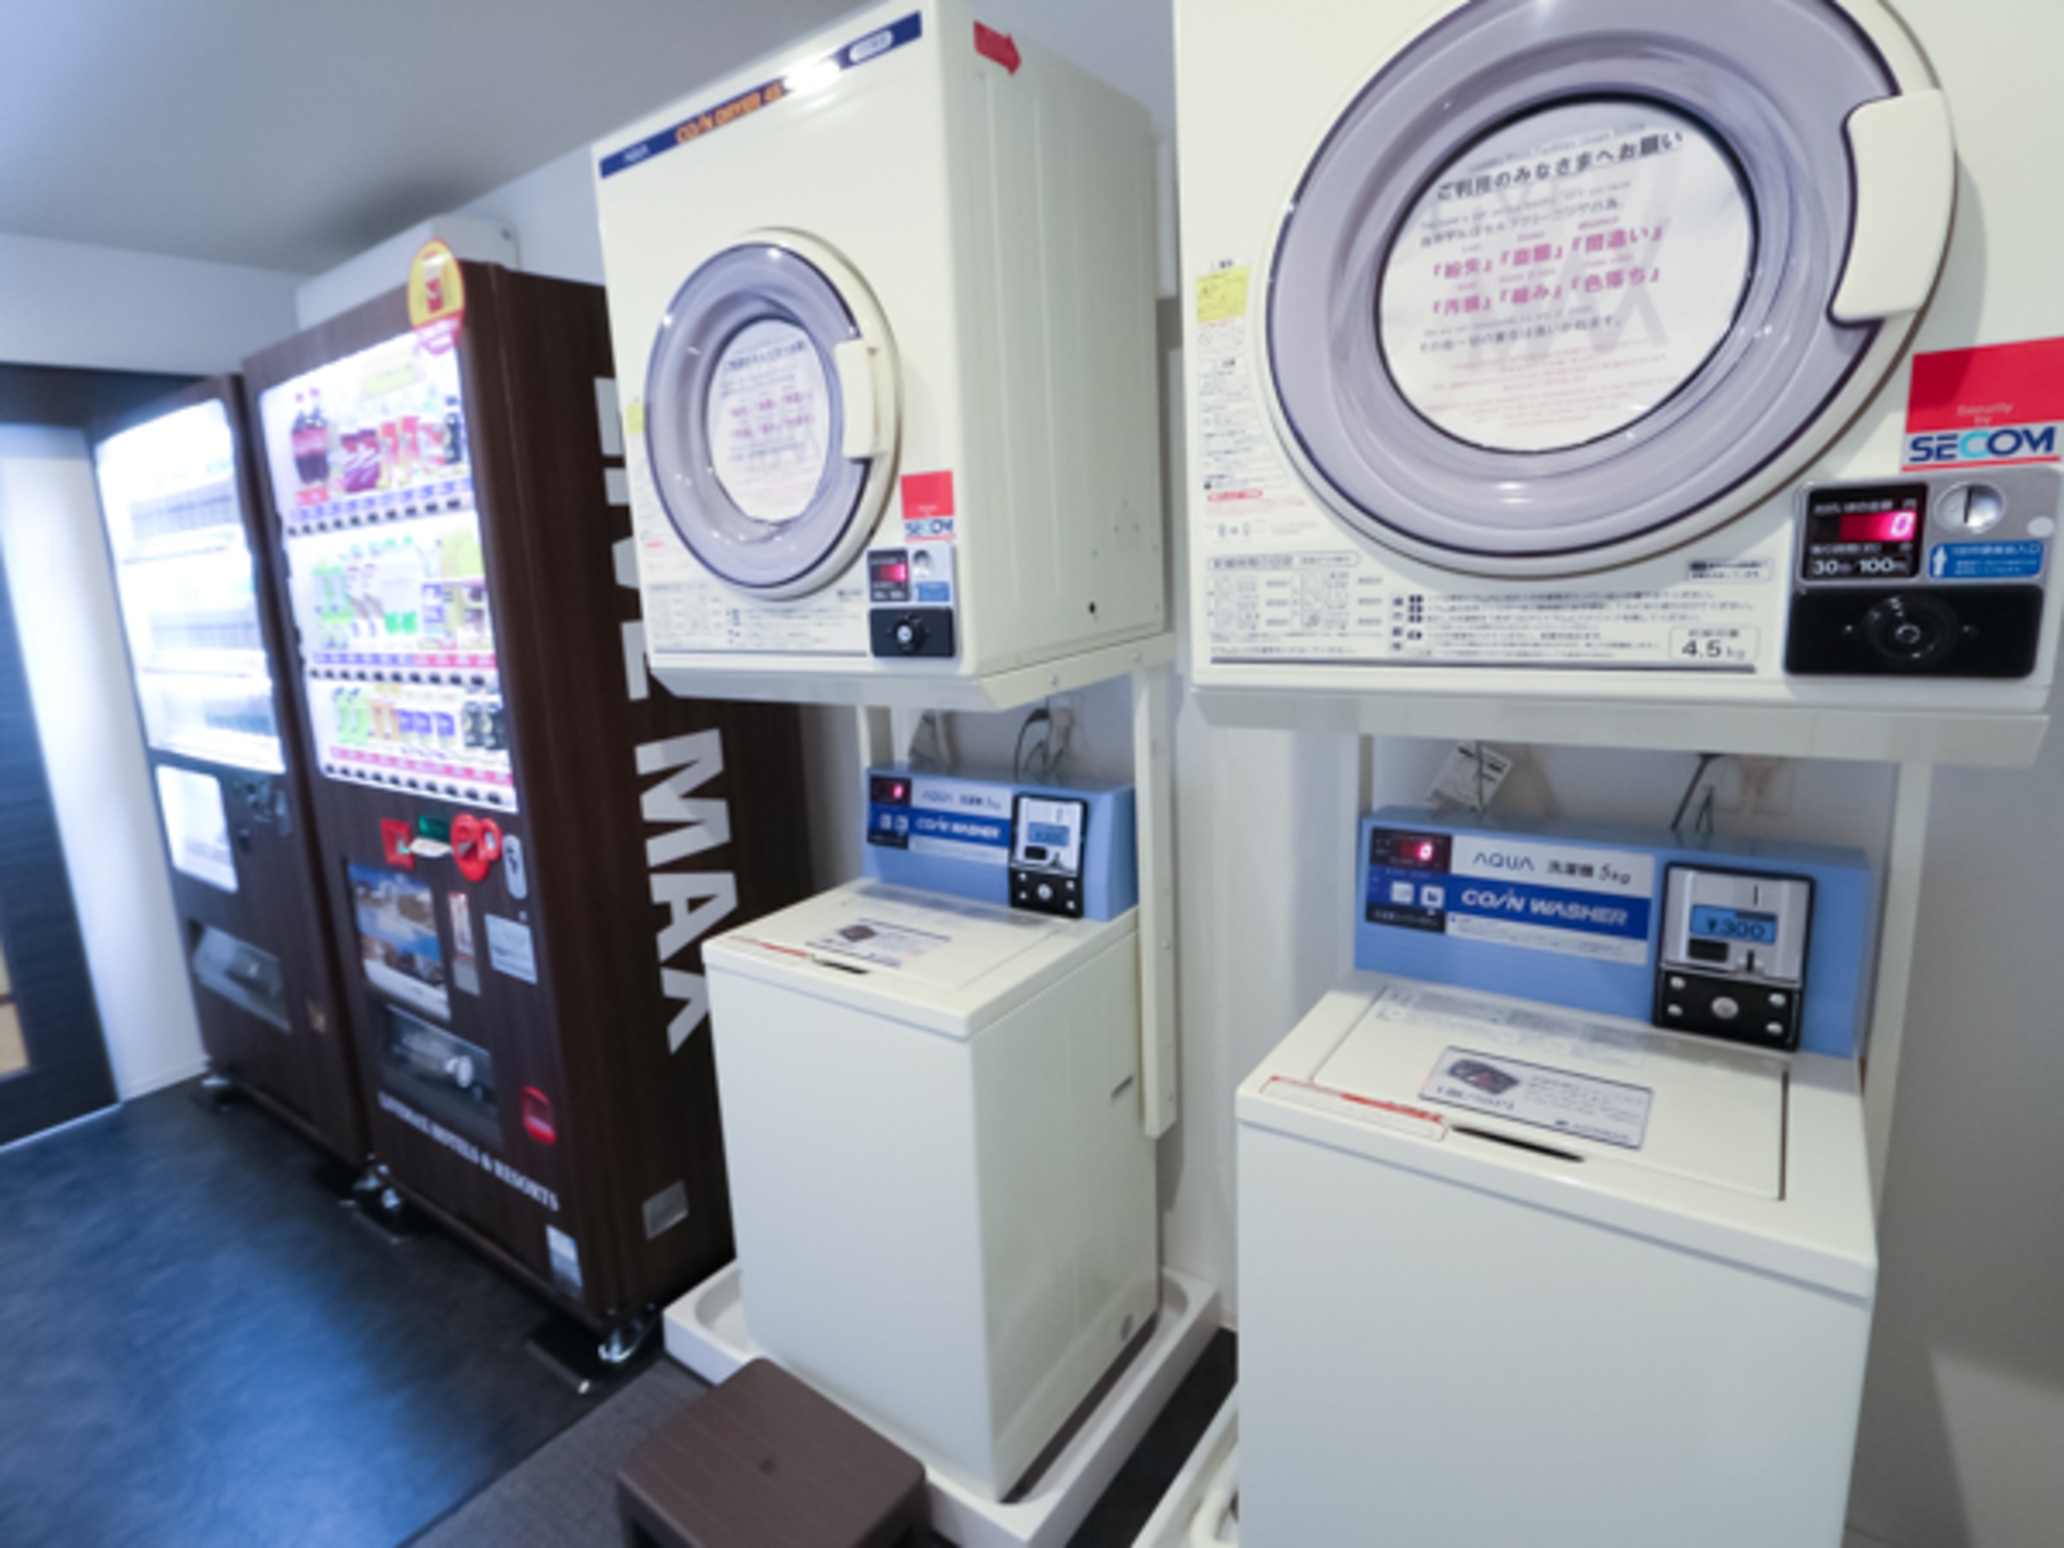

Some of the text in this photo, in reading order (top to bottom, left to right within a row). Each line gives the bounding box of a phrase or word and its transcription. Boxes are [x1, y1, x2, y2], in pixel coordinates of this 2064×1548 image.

[1437, 130, 1683, 201] ご利用のみなさまへお願い
[1957, 403, 2013, 418] Security
[1908, 426, 2056, 463] SECOM
[1890, 511, 1915, 537] 0
[1472, 852, 1535, 872] AQUA
[1529, 898, 1629, 927] WASHER
